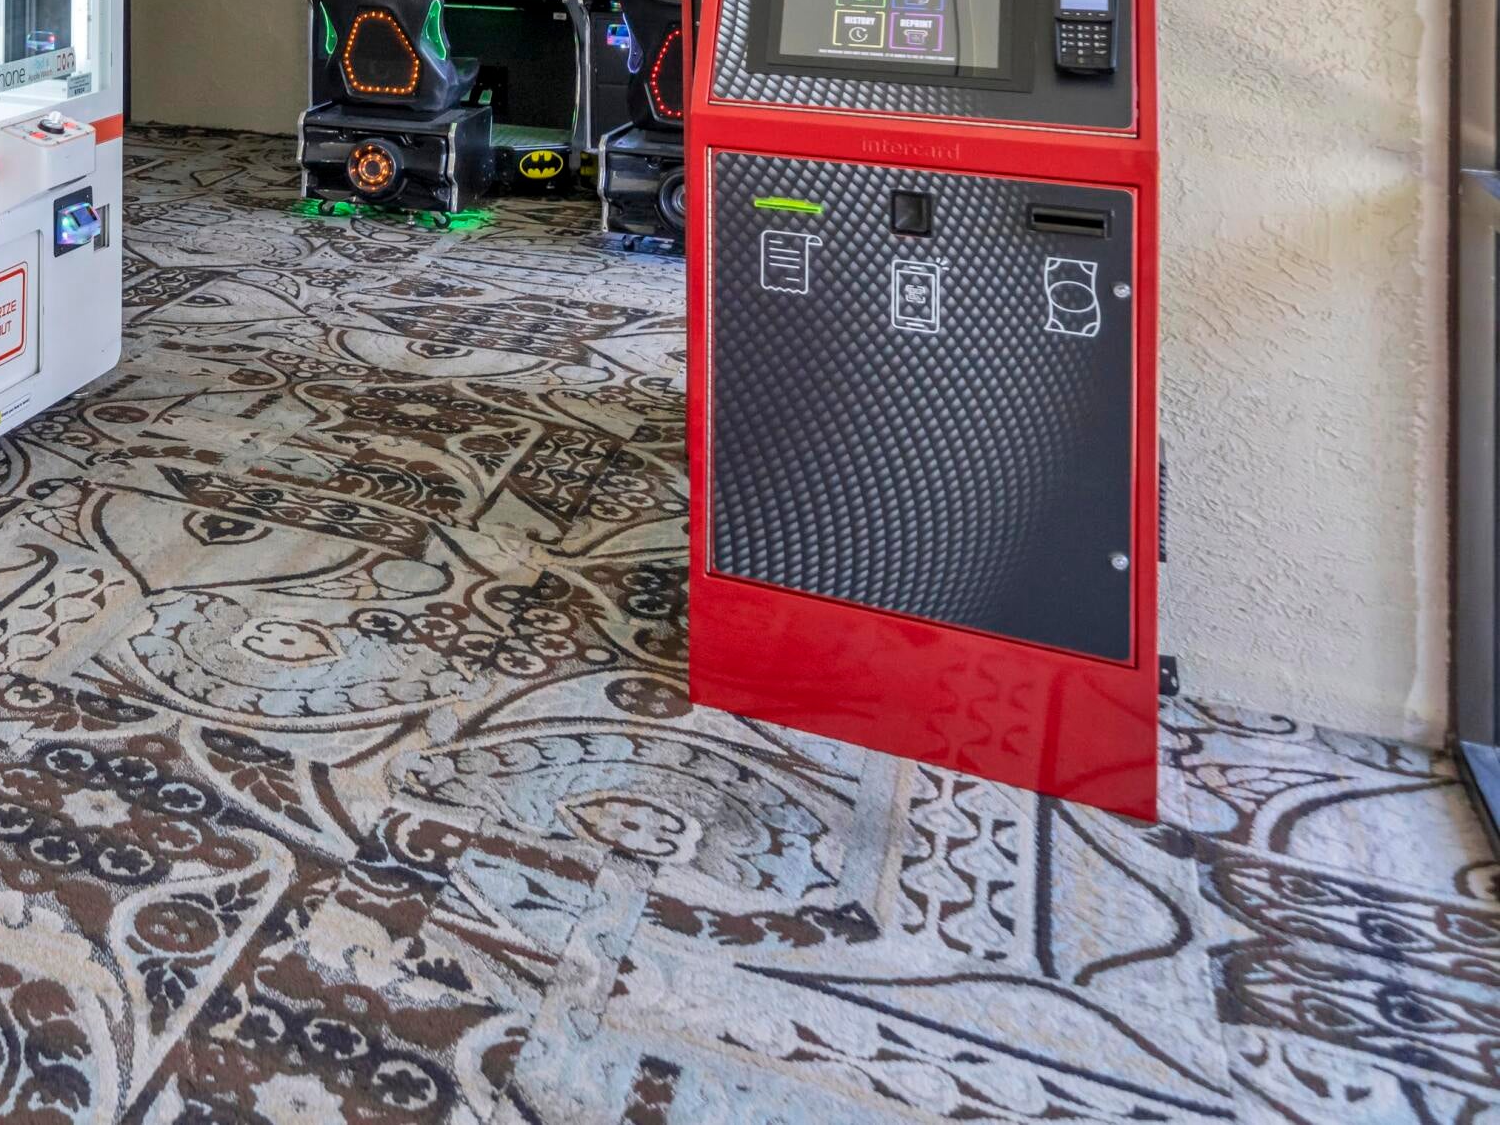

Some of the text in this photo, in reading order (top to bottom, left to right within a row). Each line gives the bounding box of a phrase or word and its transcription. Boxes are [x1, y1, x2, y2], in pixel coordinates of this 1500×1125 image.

[844, 16, 876, 26] HISTORY
[899, 19, 933, 28] REPRINT
[861, 135, 961, 161] intercard
